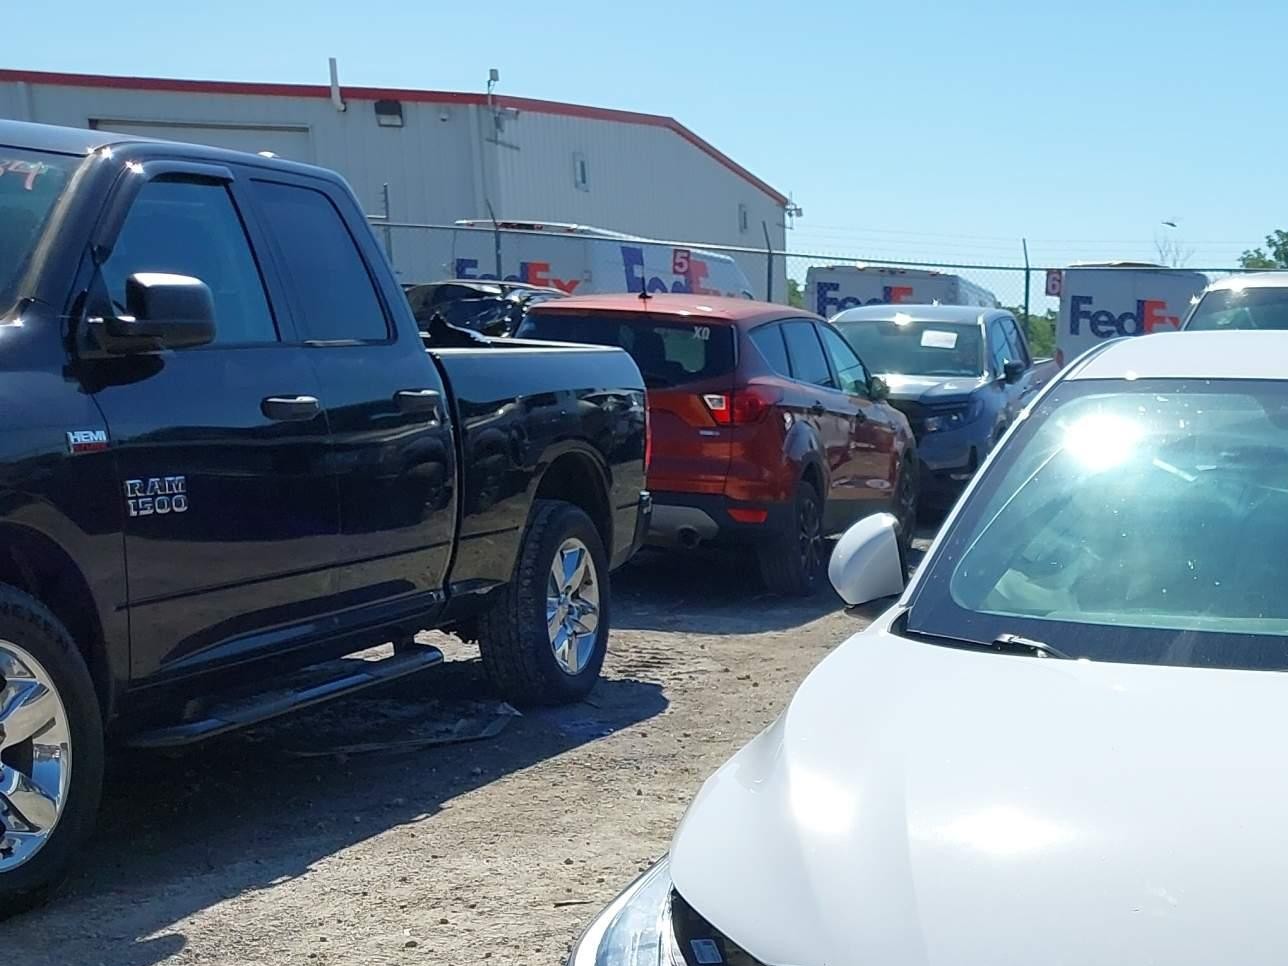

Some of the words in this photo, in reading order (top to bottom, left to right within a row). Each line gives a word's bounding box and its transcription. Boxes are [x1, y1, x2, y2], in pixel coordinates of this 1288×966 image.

[674, 251, 689, 273] 5
[455, 258, 580, 294] FEx
[1050, 272, 1061, 296] 6
[67, 430, 107, 443] HEMI
[125, 476, 187, 497] RAM
[128, 494, 188, 517] 1500
